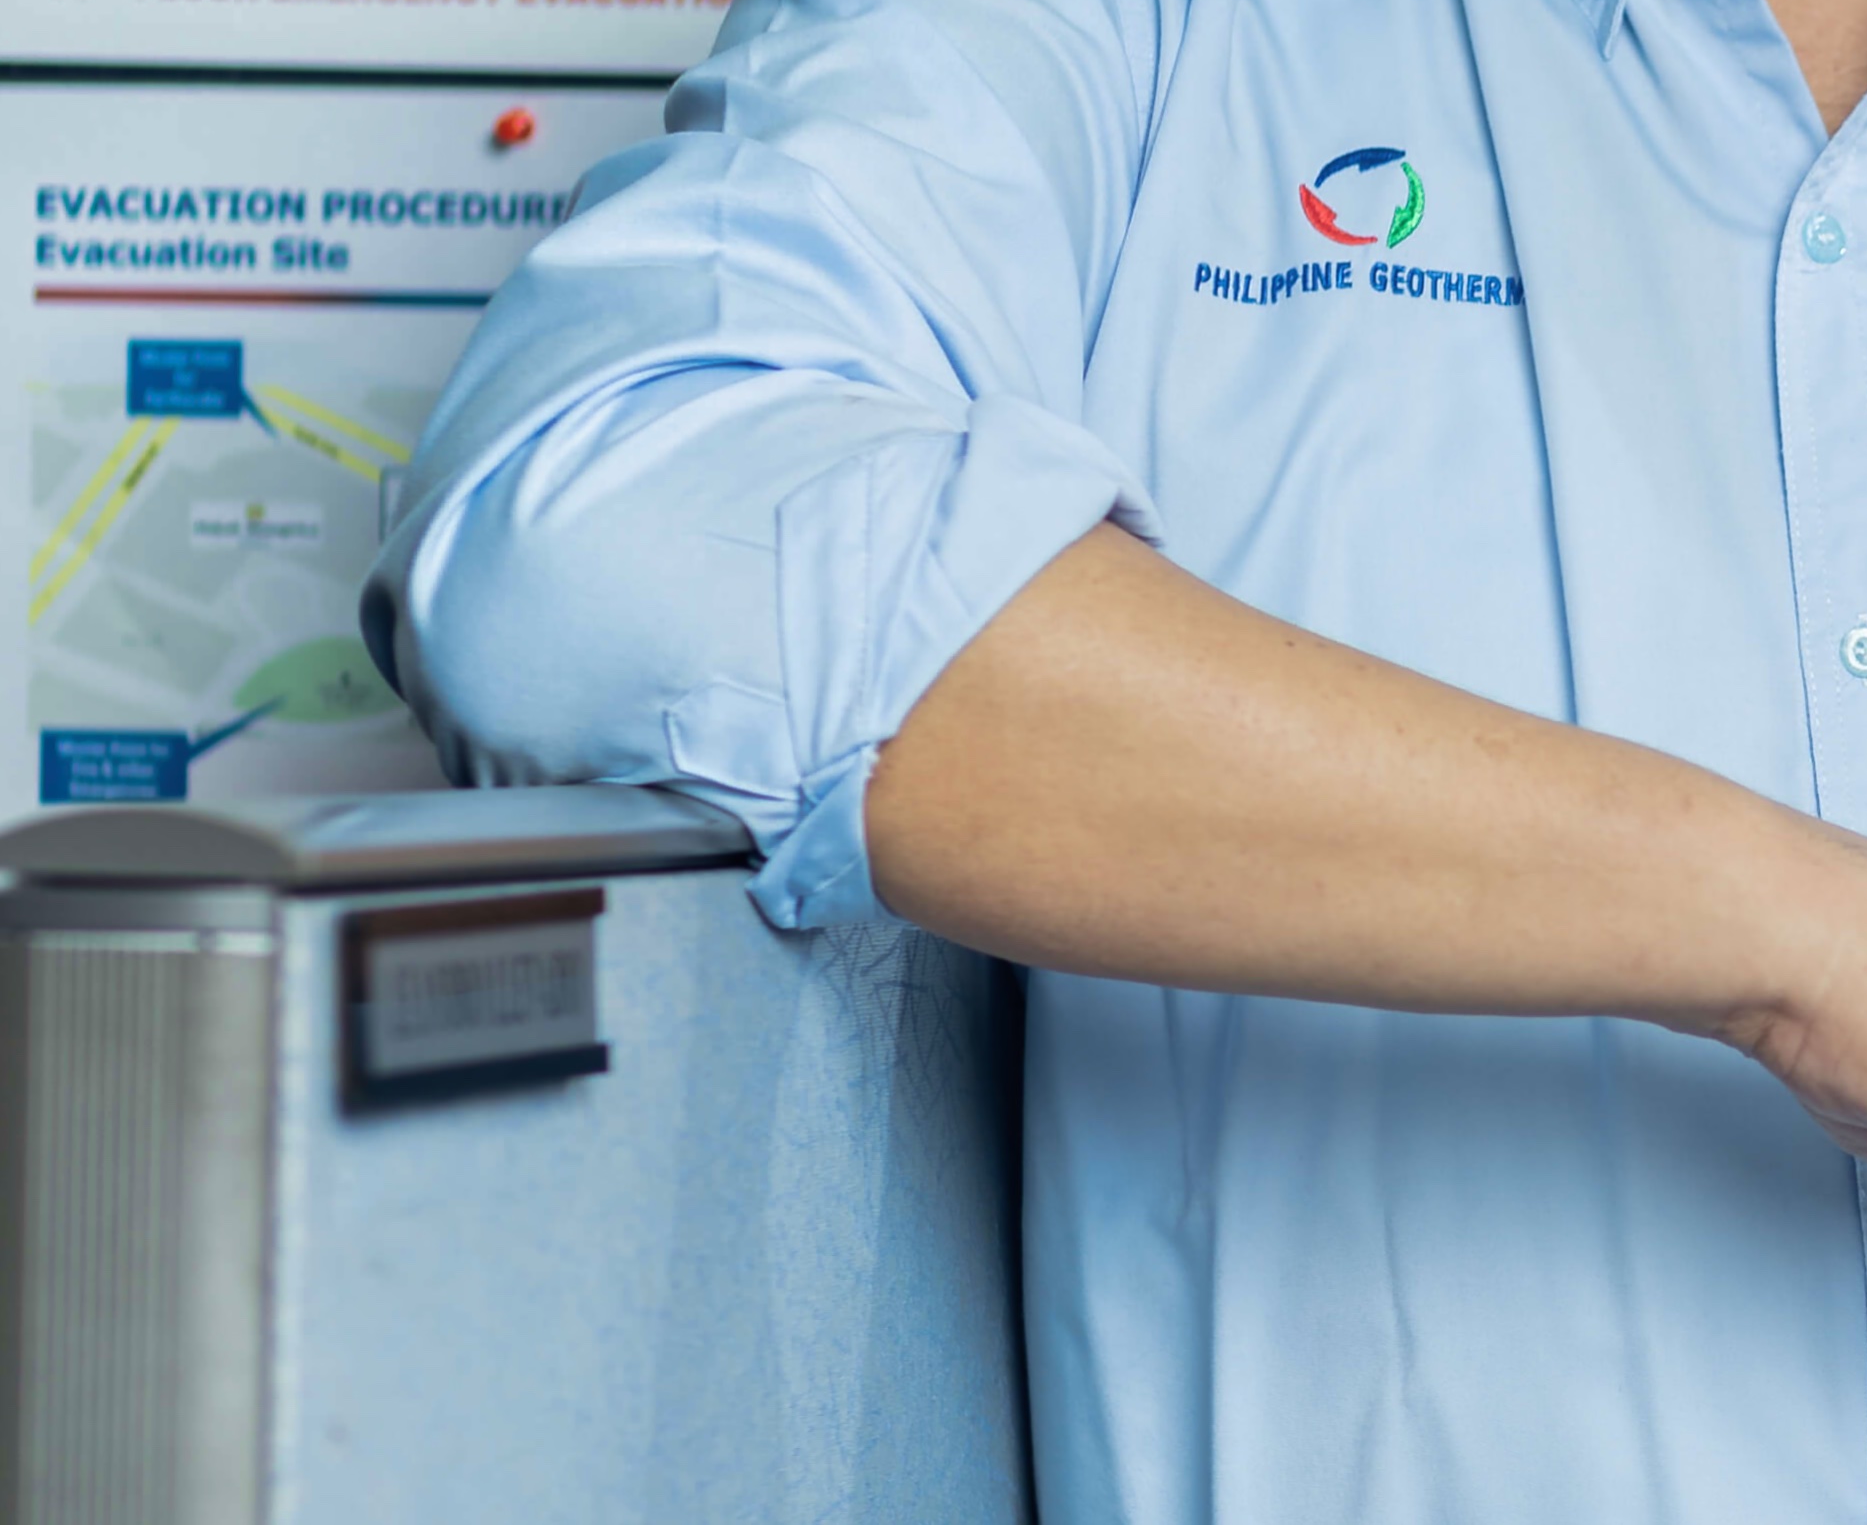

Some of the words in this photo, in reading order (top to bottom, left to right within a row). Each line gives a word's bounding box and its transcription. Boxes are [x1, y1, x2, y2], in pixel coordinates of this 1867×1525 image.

[36, 185, 307, 225] EVACUATION
[35, 234, 256, 270] Evacuation
[272, 236, 349, 272] Site
[1193, 261, 1353, 306] PHILIPPINE
[1369, 260, 1525, 306] GEOTHERM
